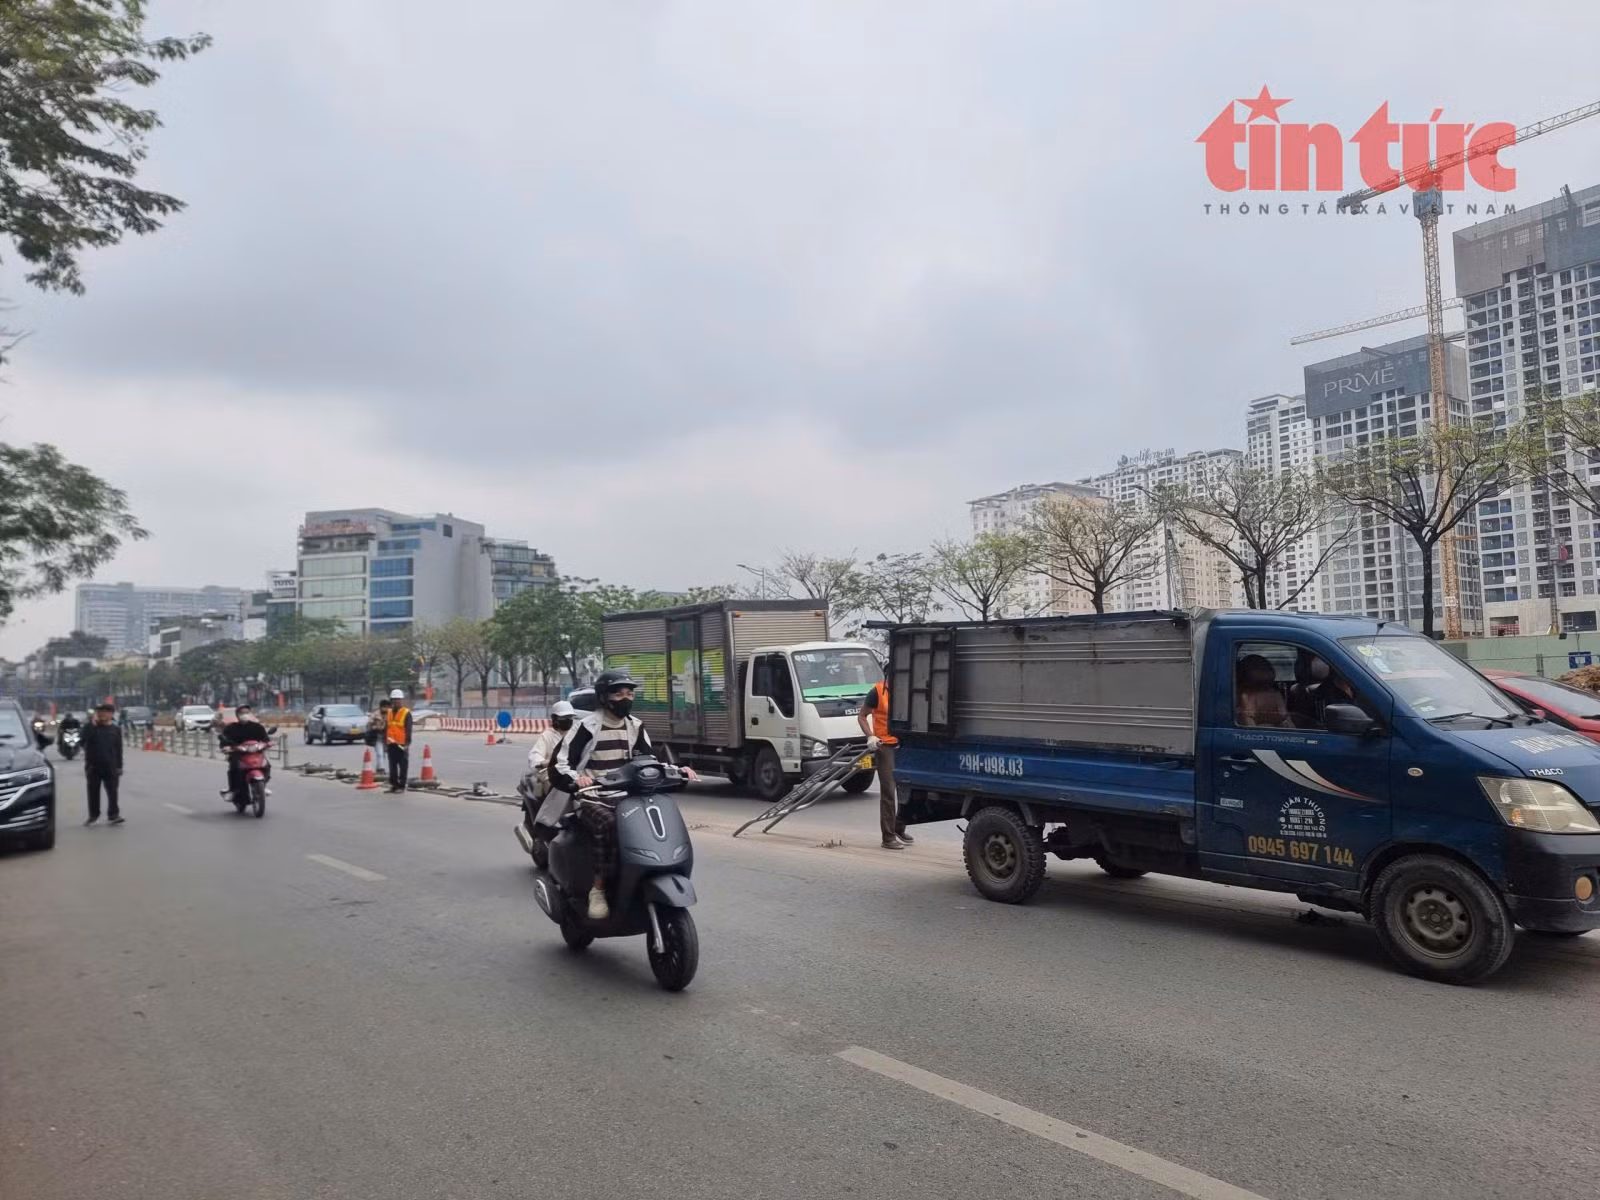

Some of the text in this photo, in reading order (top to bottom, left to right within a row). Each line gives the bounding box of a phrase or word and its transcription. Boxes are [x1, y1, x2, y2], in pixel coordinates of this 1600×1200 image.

[1324, 366, 1396, 398] PRIME
[273, 579, 295, 587] TOTO
[1233, 733, 1264, 741] THACO
[1529, 768, 1564, 777] THACO
[1248, 835, 1354, 867] 0945 697 144
